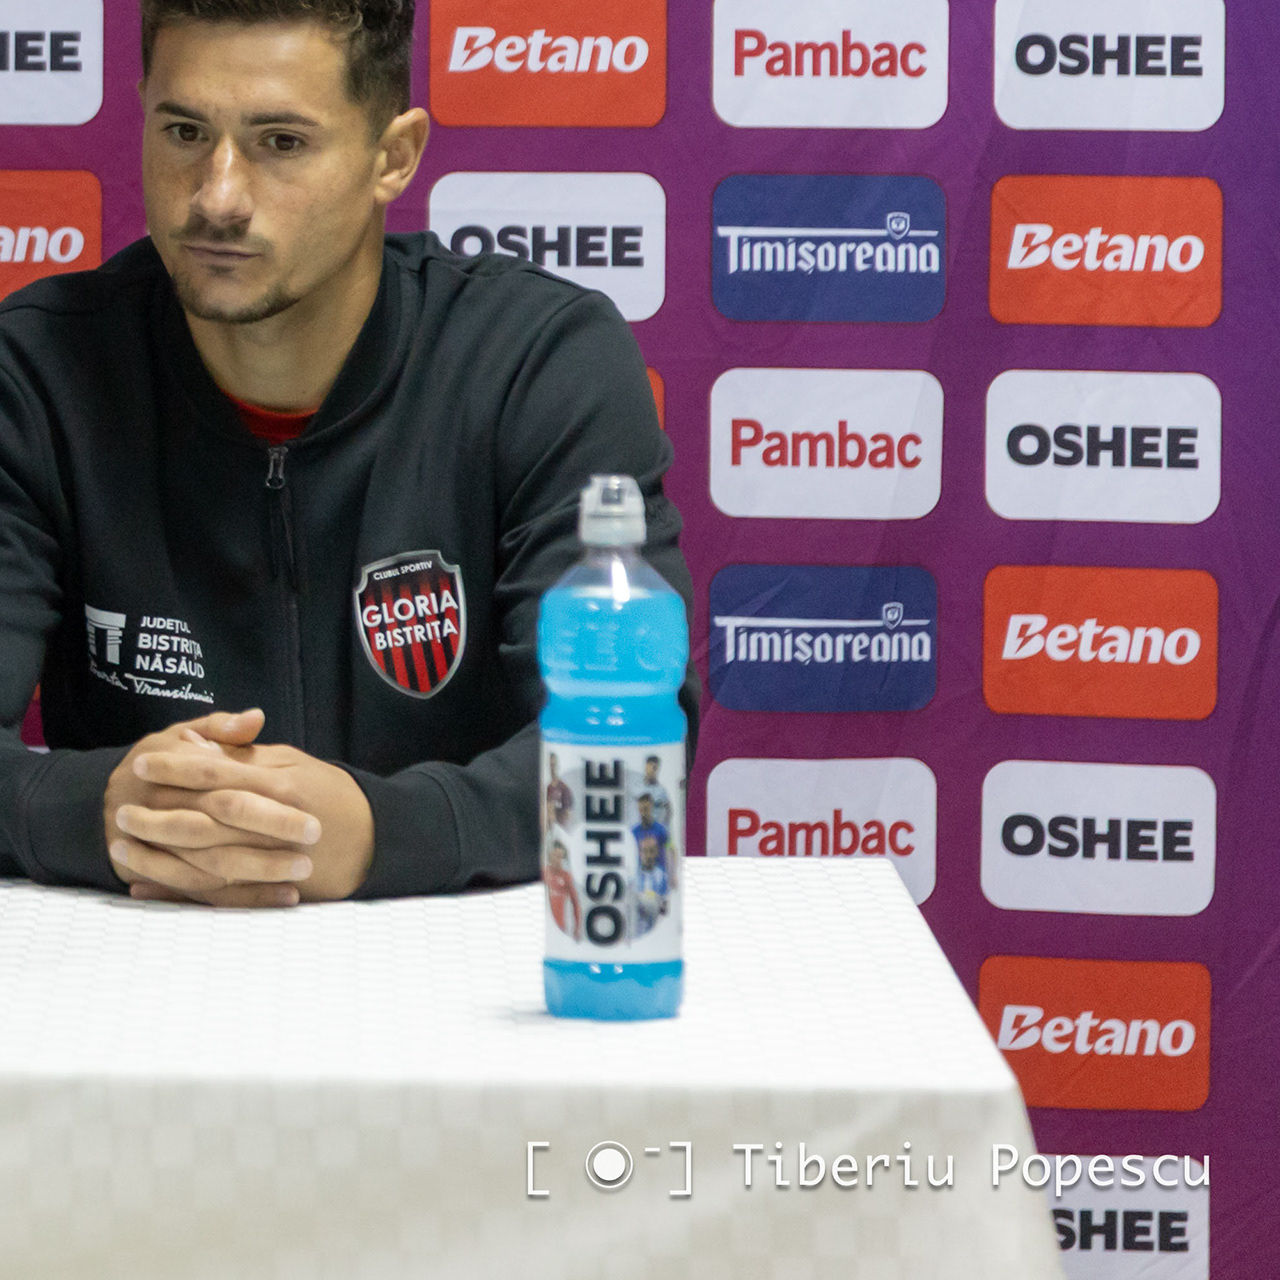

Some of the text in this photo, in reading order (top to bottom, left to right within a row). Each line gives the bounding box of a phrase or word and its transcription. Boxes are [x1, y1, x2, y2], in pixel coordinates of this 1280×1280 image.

[447, 26, 649, 73] Betano
[733, 29, 926, 78] Pambac
[1014, 33, 1203, 77] OSHEE
[449, 224, 645, 269] OSHEE
[1007, 223, 1206, 273] Betano
[731, 418, 922, 469] Pambac
[1005, 423, 1201, 471] OSHEE
[399, 560, 433, 575] SPORTIV
[362, 589, 459, 629] GLORIA
[137, 632, 204, 661] BISTRIȚA
[374, 618, 459, 652] BISTRIȚA
[1001, 613, 1202, 666] Betano
[134, 653, 206, 680] NĂSĂUD
[585, 758, 626, 947] OSHEE
[727, 808, 915, 858] Pambac
[1000, 813, 1195, 863] OSHEE
[996, 1003, 1196, 1058] Betano
[1052, 1208, 1190, 1253] SHEE
